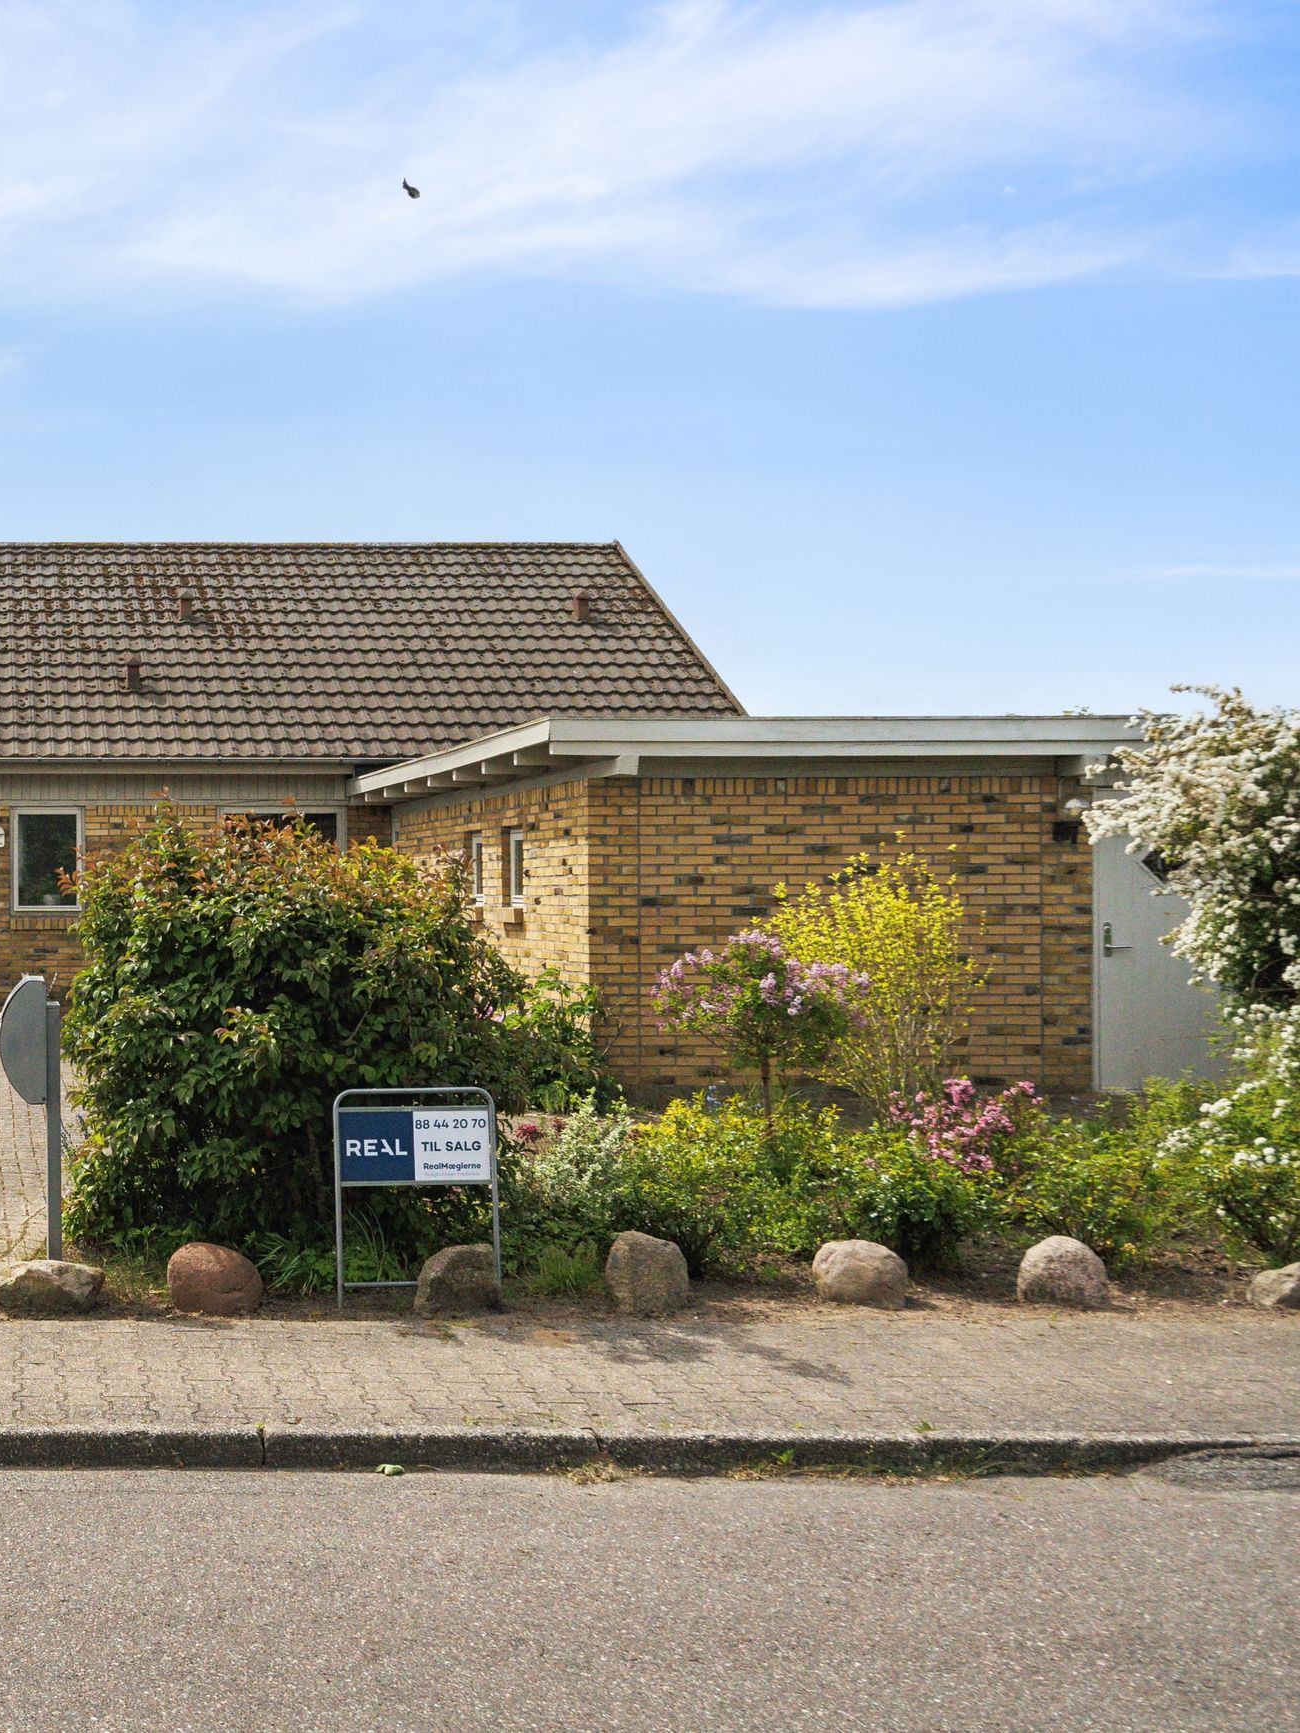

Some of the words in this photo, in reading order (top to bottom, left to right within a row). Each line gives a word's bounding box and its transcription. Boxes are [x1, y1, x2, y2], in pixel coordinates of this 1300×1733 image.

[415, 1119, 430, 1129] 88
[433, 1119, 449, 1129] 44
[453, 1119, 468, 1128] 20
[472, 1118, 486, 1128] 70
[346, 1139, 408, 1157] REAL
[421, 1142, 441, 1152] TIL
[445, 1141, 482, 1151] SALG
[423, 1162, 481, 1171] RealMæglerne
